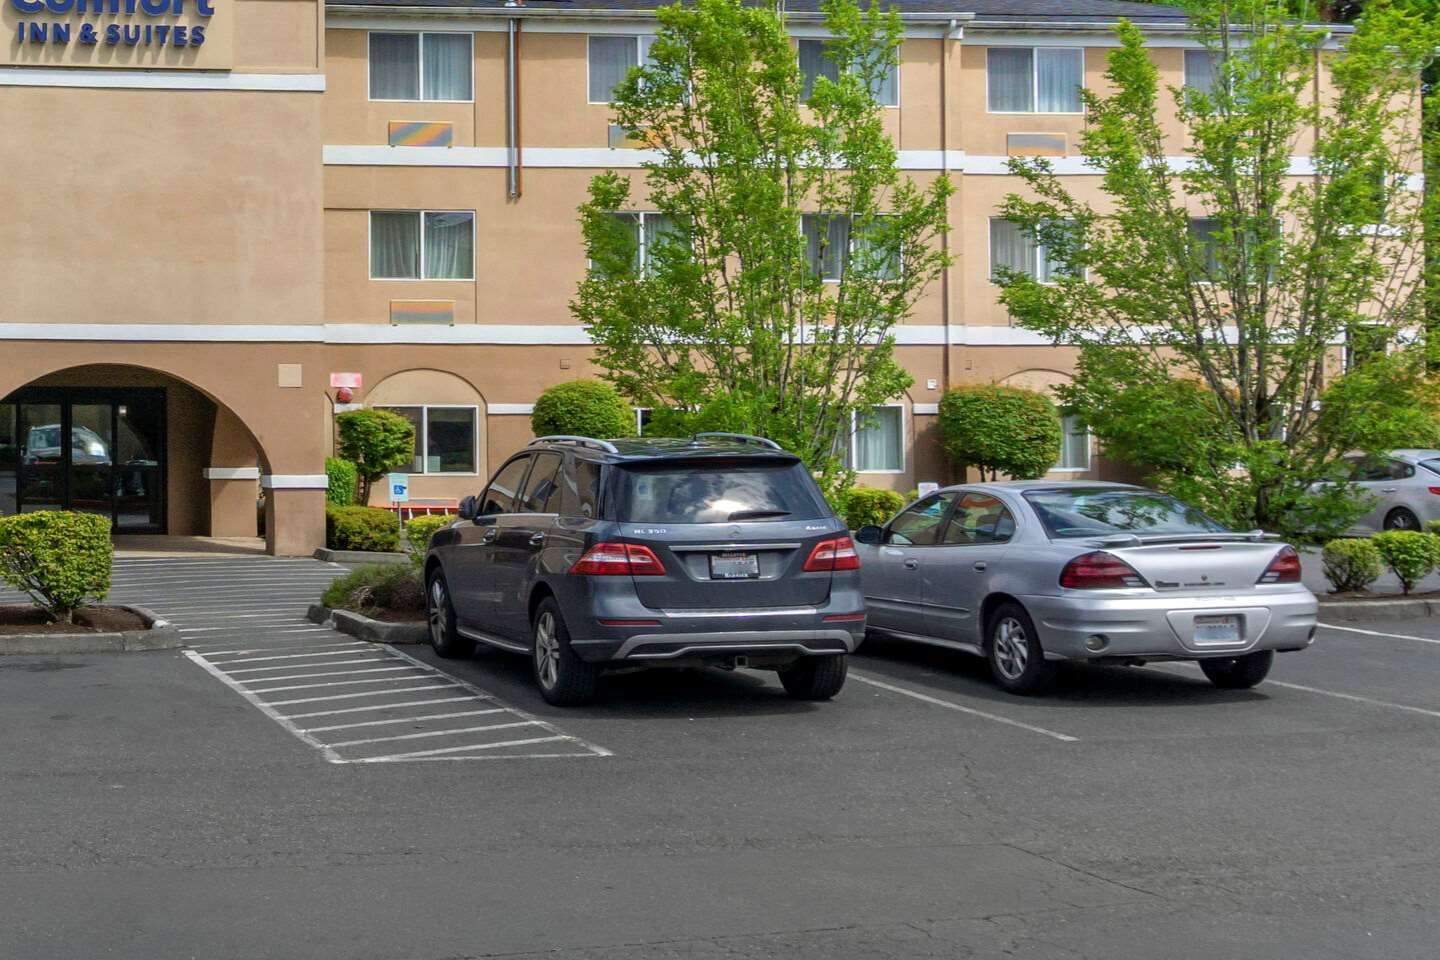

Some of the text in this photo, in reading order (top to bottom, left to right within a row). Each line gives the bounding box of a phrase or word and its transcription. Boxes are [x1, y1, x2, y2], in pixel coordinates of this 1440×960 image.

[18, 22, 205, 47] INN & SUITES
